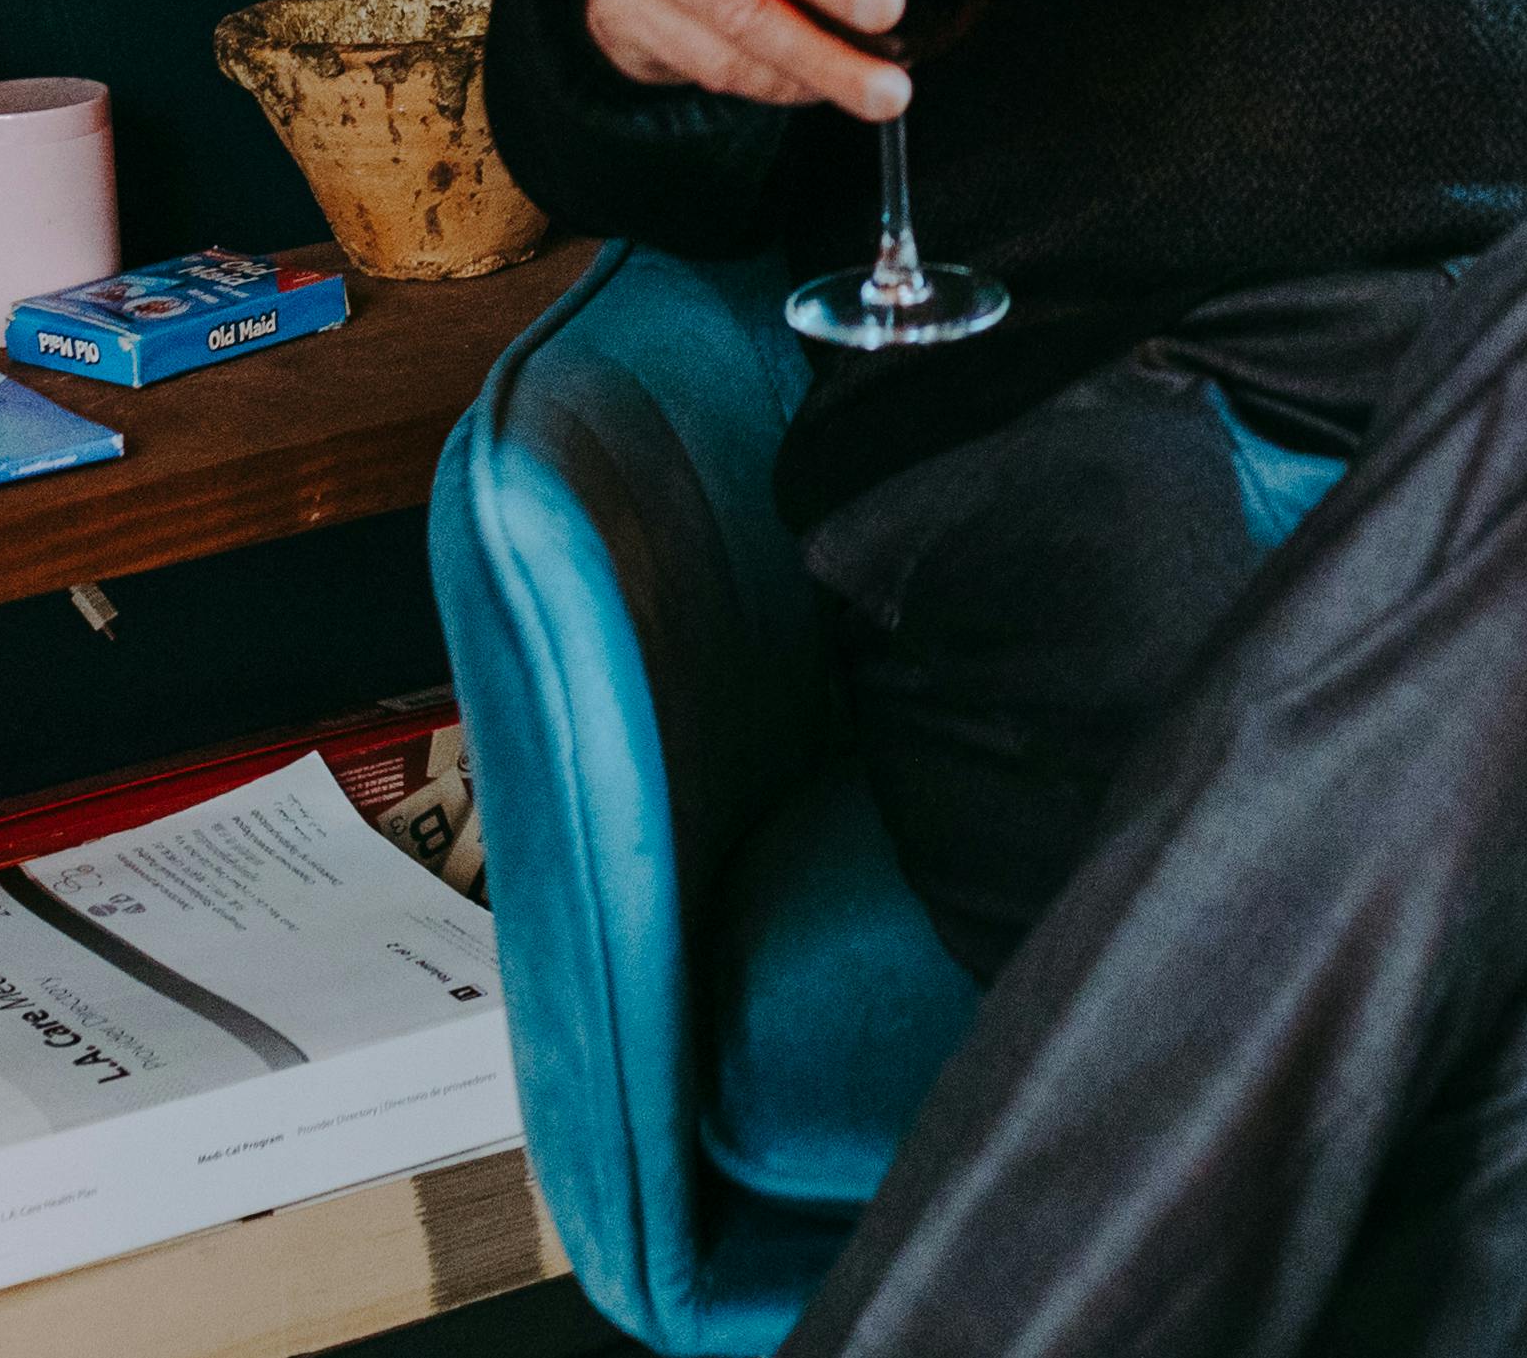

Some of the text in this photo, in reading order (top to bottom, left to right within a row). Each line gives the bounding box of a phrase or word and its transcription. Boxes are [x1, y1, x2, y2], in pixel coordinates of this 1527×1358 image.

[37, 331, 101, 365] Old Maid
[207, 312, 277, 352] Old Maid
[409, 803, 454, 860] B
[21, 1008, 84, 1050] Care
[37, 974, 170, 1071] Provider Directory
[74, 1044, 131, 1086] L.A.
[296, 1071, 498, 1137] Provider Directory Directorio de proveedores
[196, 1131, 285, 1165] Medi-Cal Program
[19, 1201, 43, 1218] Care
[43, 1192, 76, 1212] Health
[76, 1187, 99, 1203] Plan
